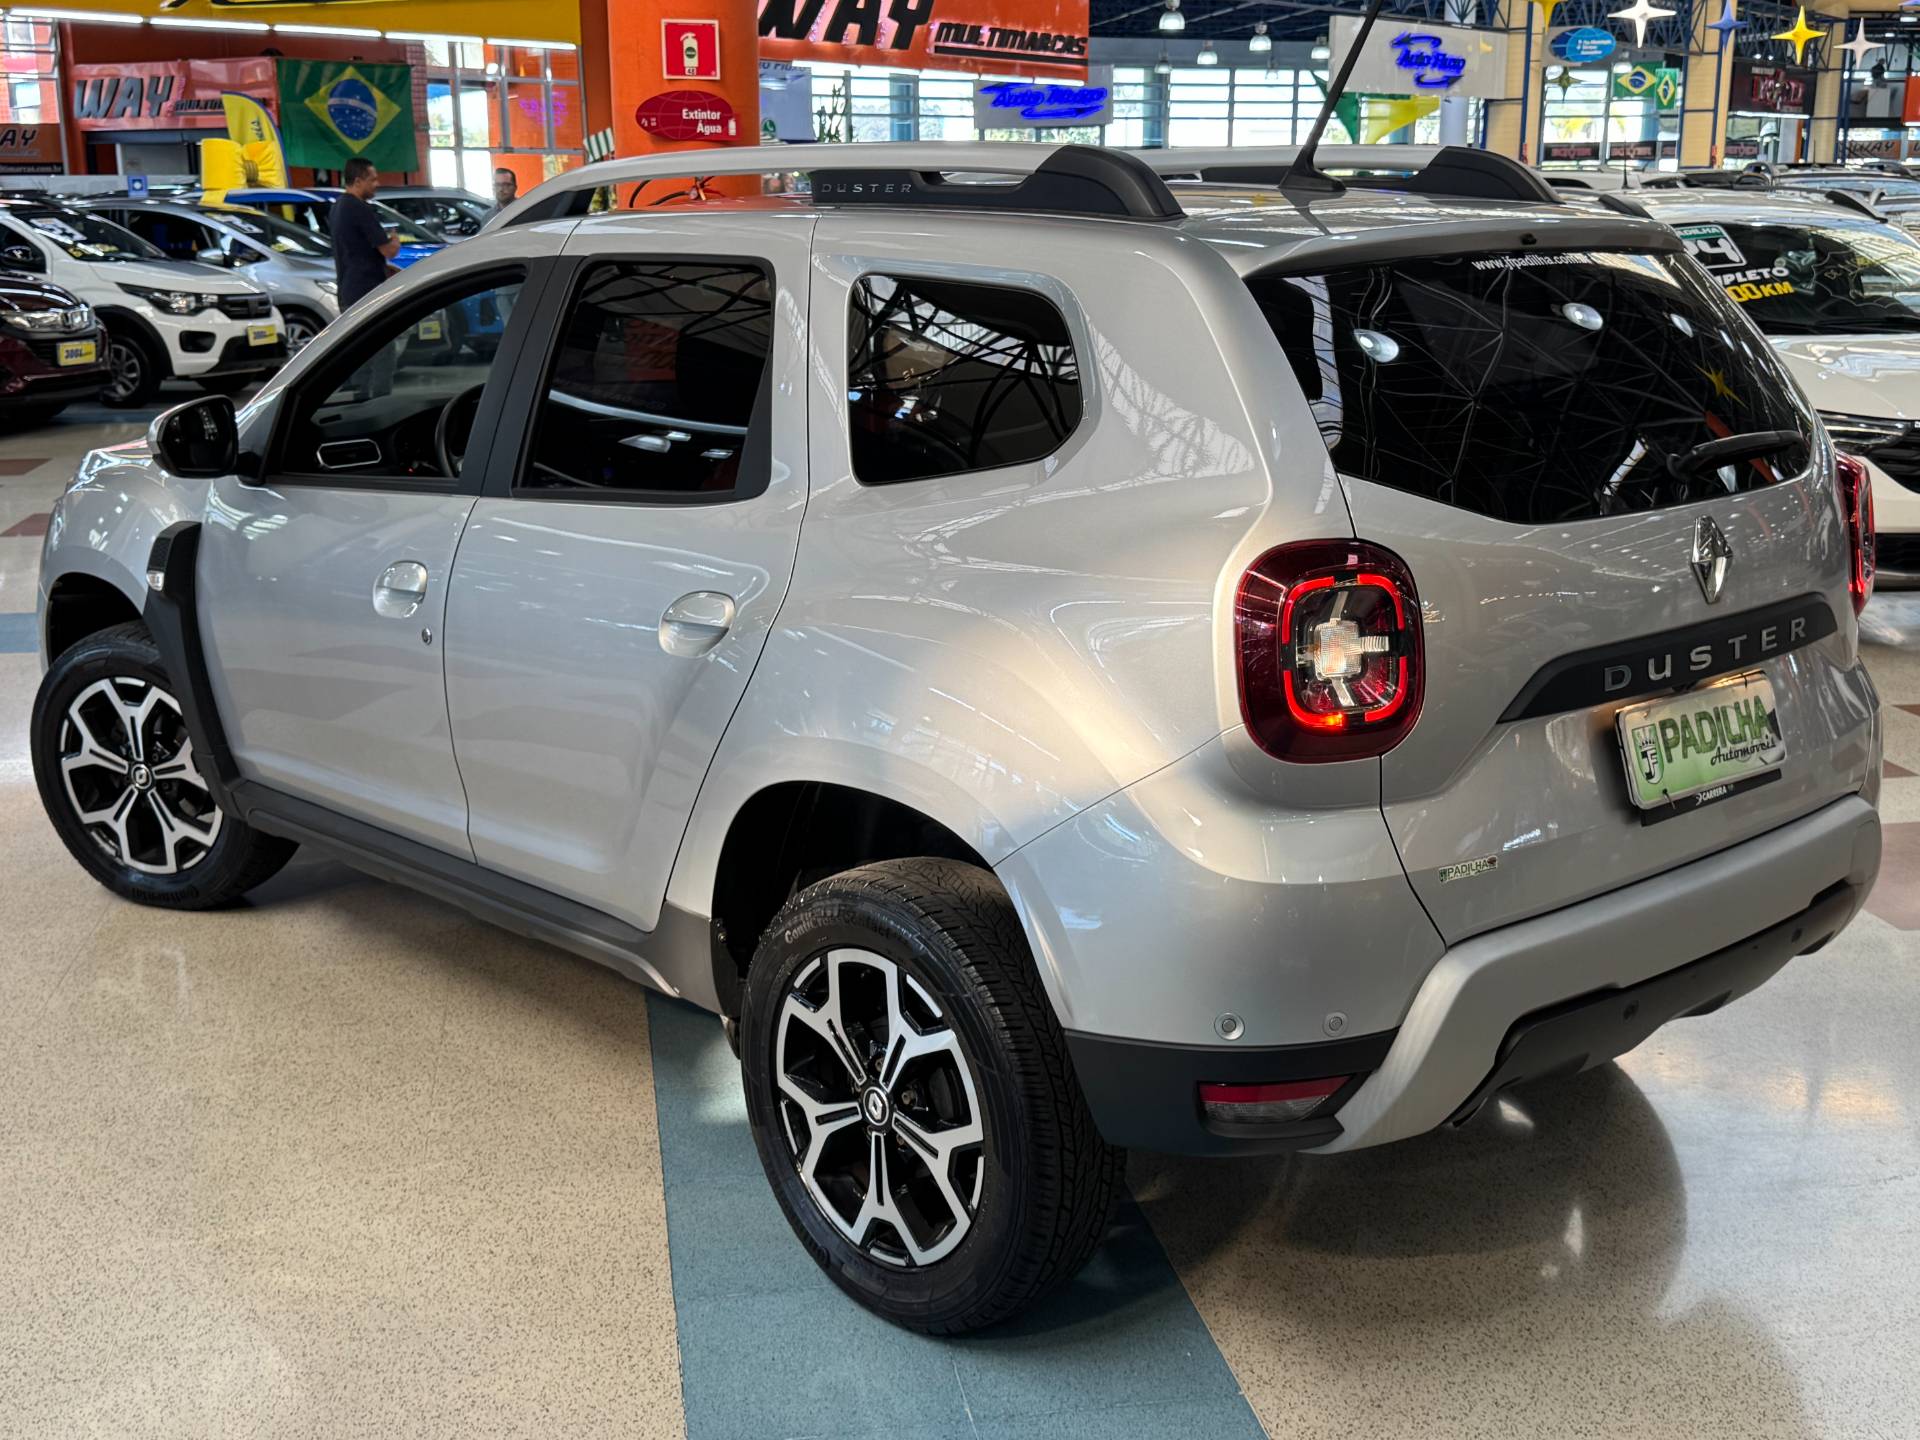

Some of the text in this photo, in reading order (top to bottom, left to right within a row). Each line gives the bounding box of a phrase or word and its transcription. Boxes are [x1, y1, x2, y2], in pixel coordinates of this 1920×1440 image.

[935, 22, 1089, 56] MULTIMARCAS
[74, 75, 175, 119] WAY
[682, 107, 721, 120] Extintor
[696, 120, 722, 136] Água
[0, 129, 37, 147] AY
[821, 183, 912, 193] DUSTER
[1676, 227, 1721, 236] ADILHA
[1713, 266, 1790, 286] MPLETO
[1604, 617, 1807, 692] DUSTER
[1659, 695, 1768, 763] PADILHA
[1448, 859, 1489, 877] PADILHA
